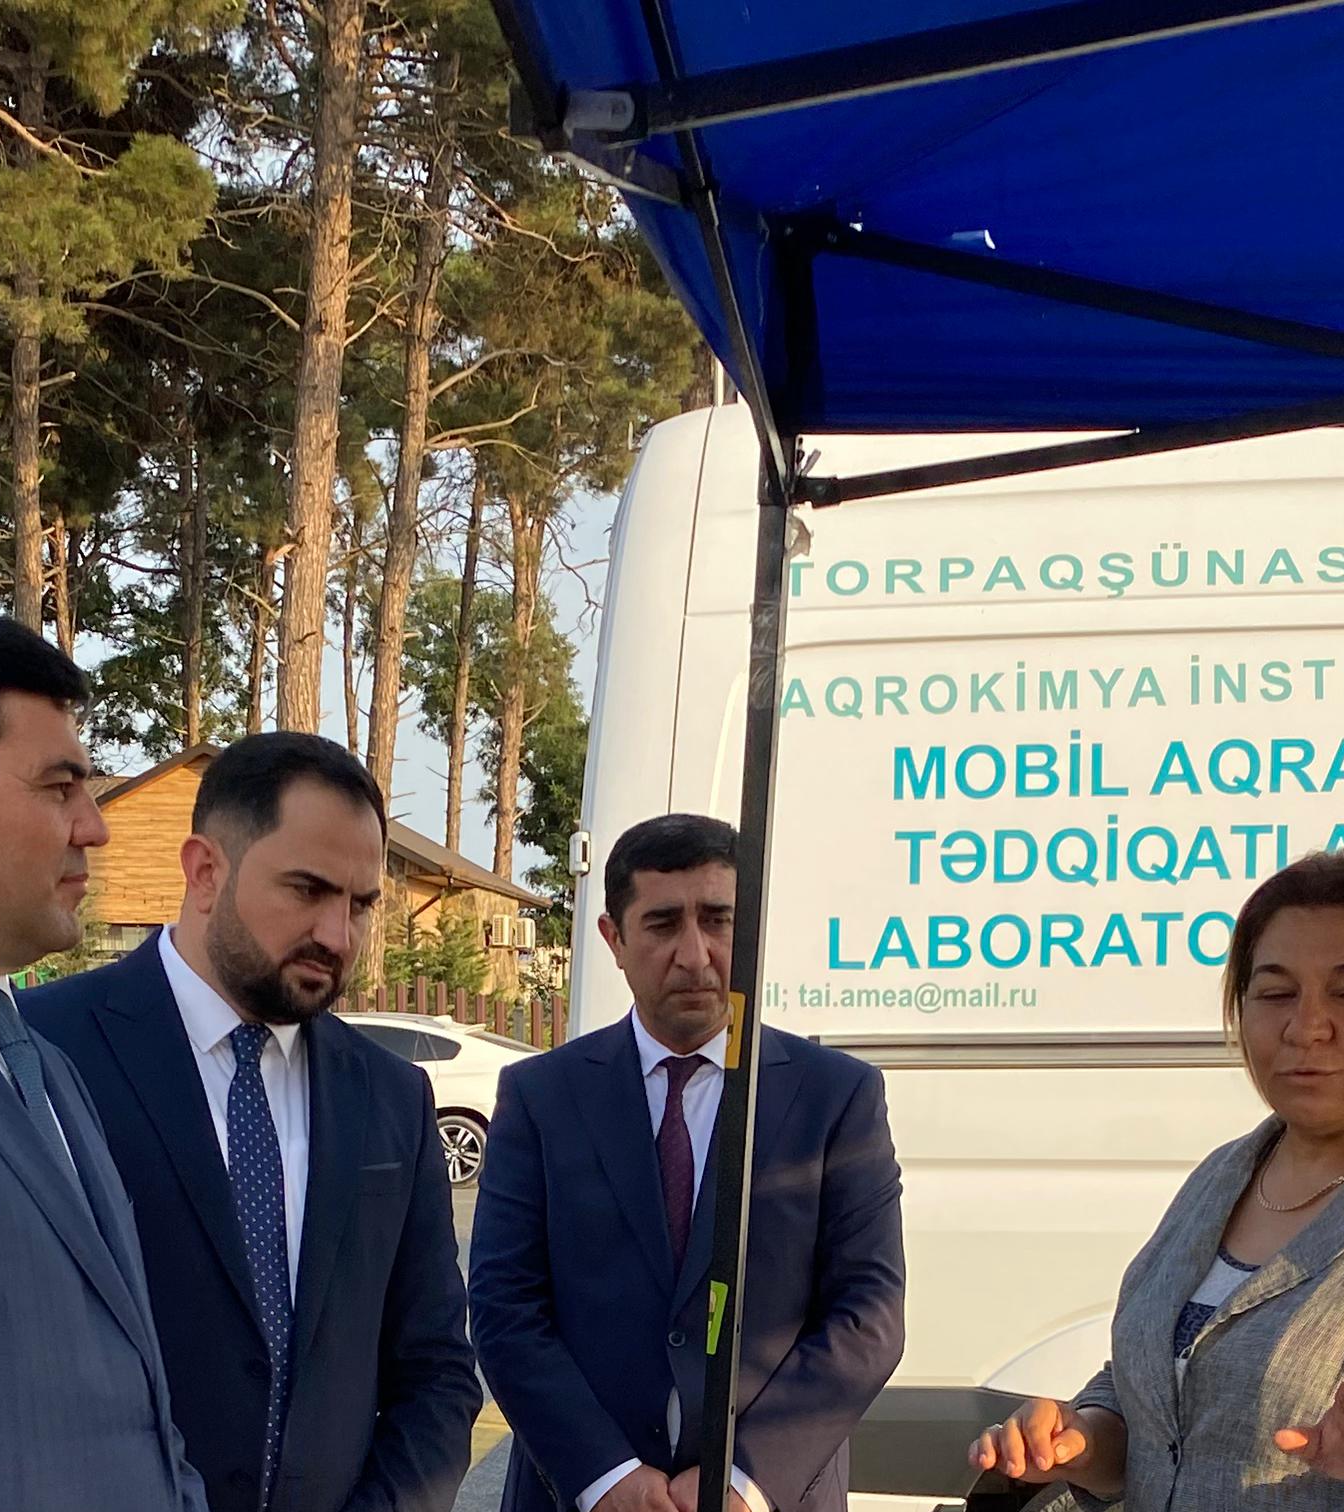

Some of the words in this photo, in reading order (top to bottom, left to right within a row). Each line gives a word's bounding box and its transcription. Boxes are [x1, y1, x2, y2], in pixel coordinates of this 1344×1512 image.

[779, 662, 1166, 719] AQROKİMYA
[893, 730, 1129, 800] MOBİL
[799, 982, 1037, 1012] tai.amea@mail.ru
